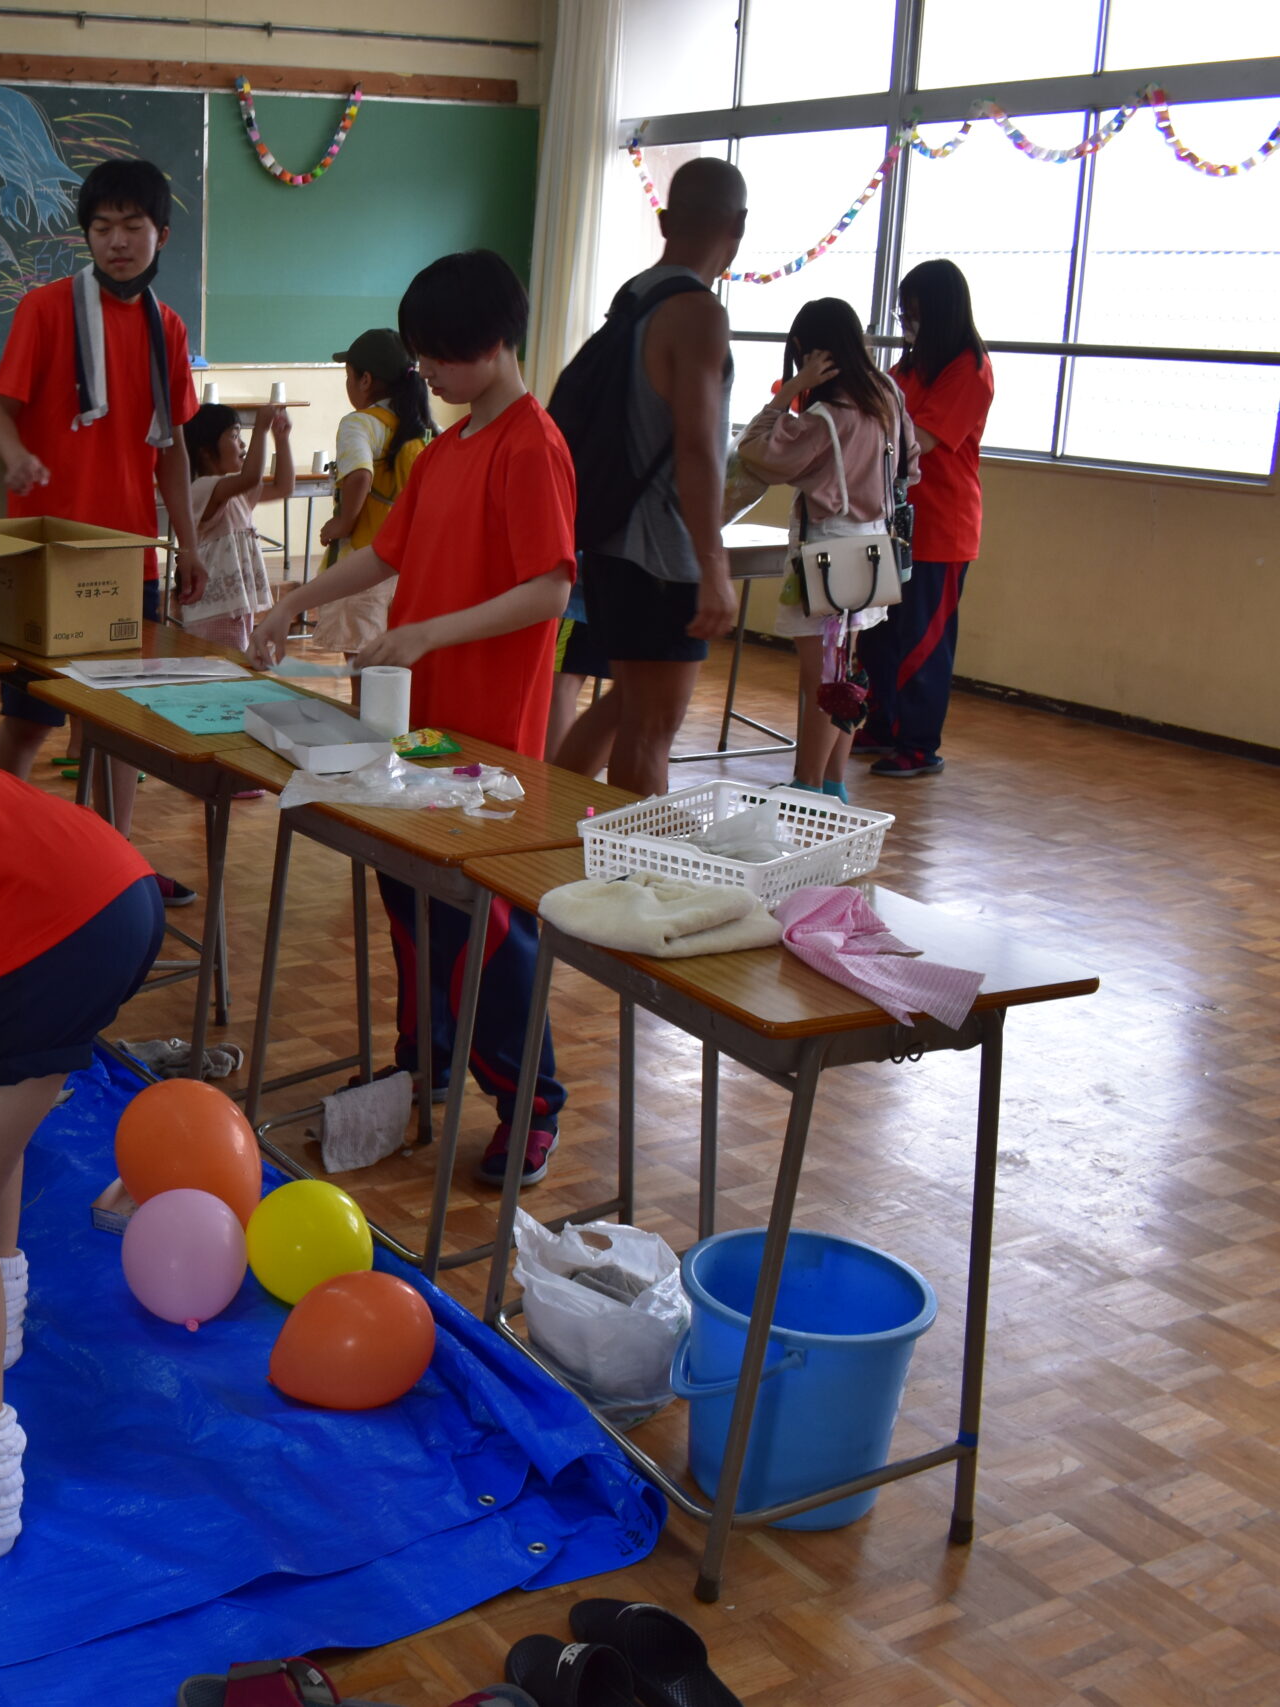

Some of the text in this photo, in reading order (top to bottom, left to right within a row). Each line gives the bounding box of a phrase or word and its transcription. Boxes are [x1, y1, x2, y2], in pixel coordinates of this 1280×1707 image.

[75, 586, 119, 598] マヨネーズ
